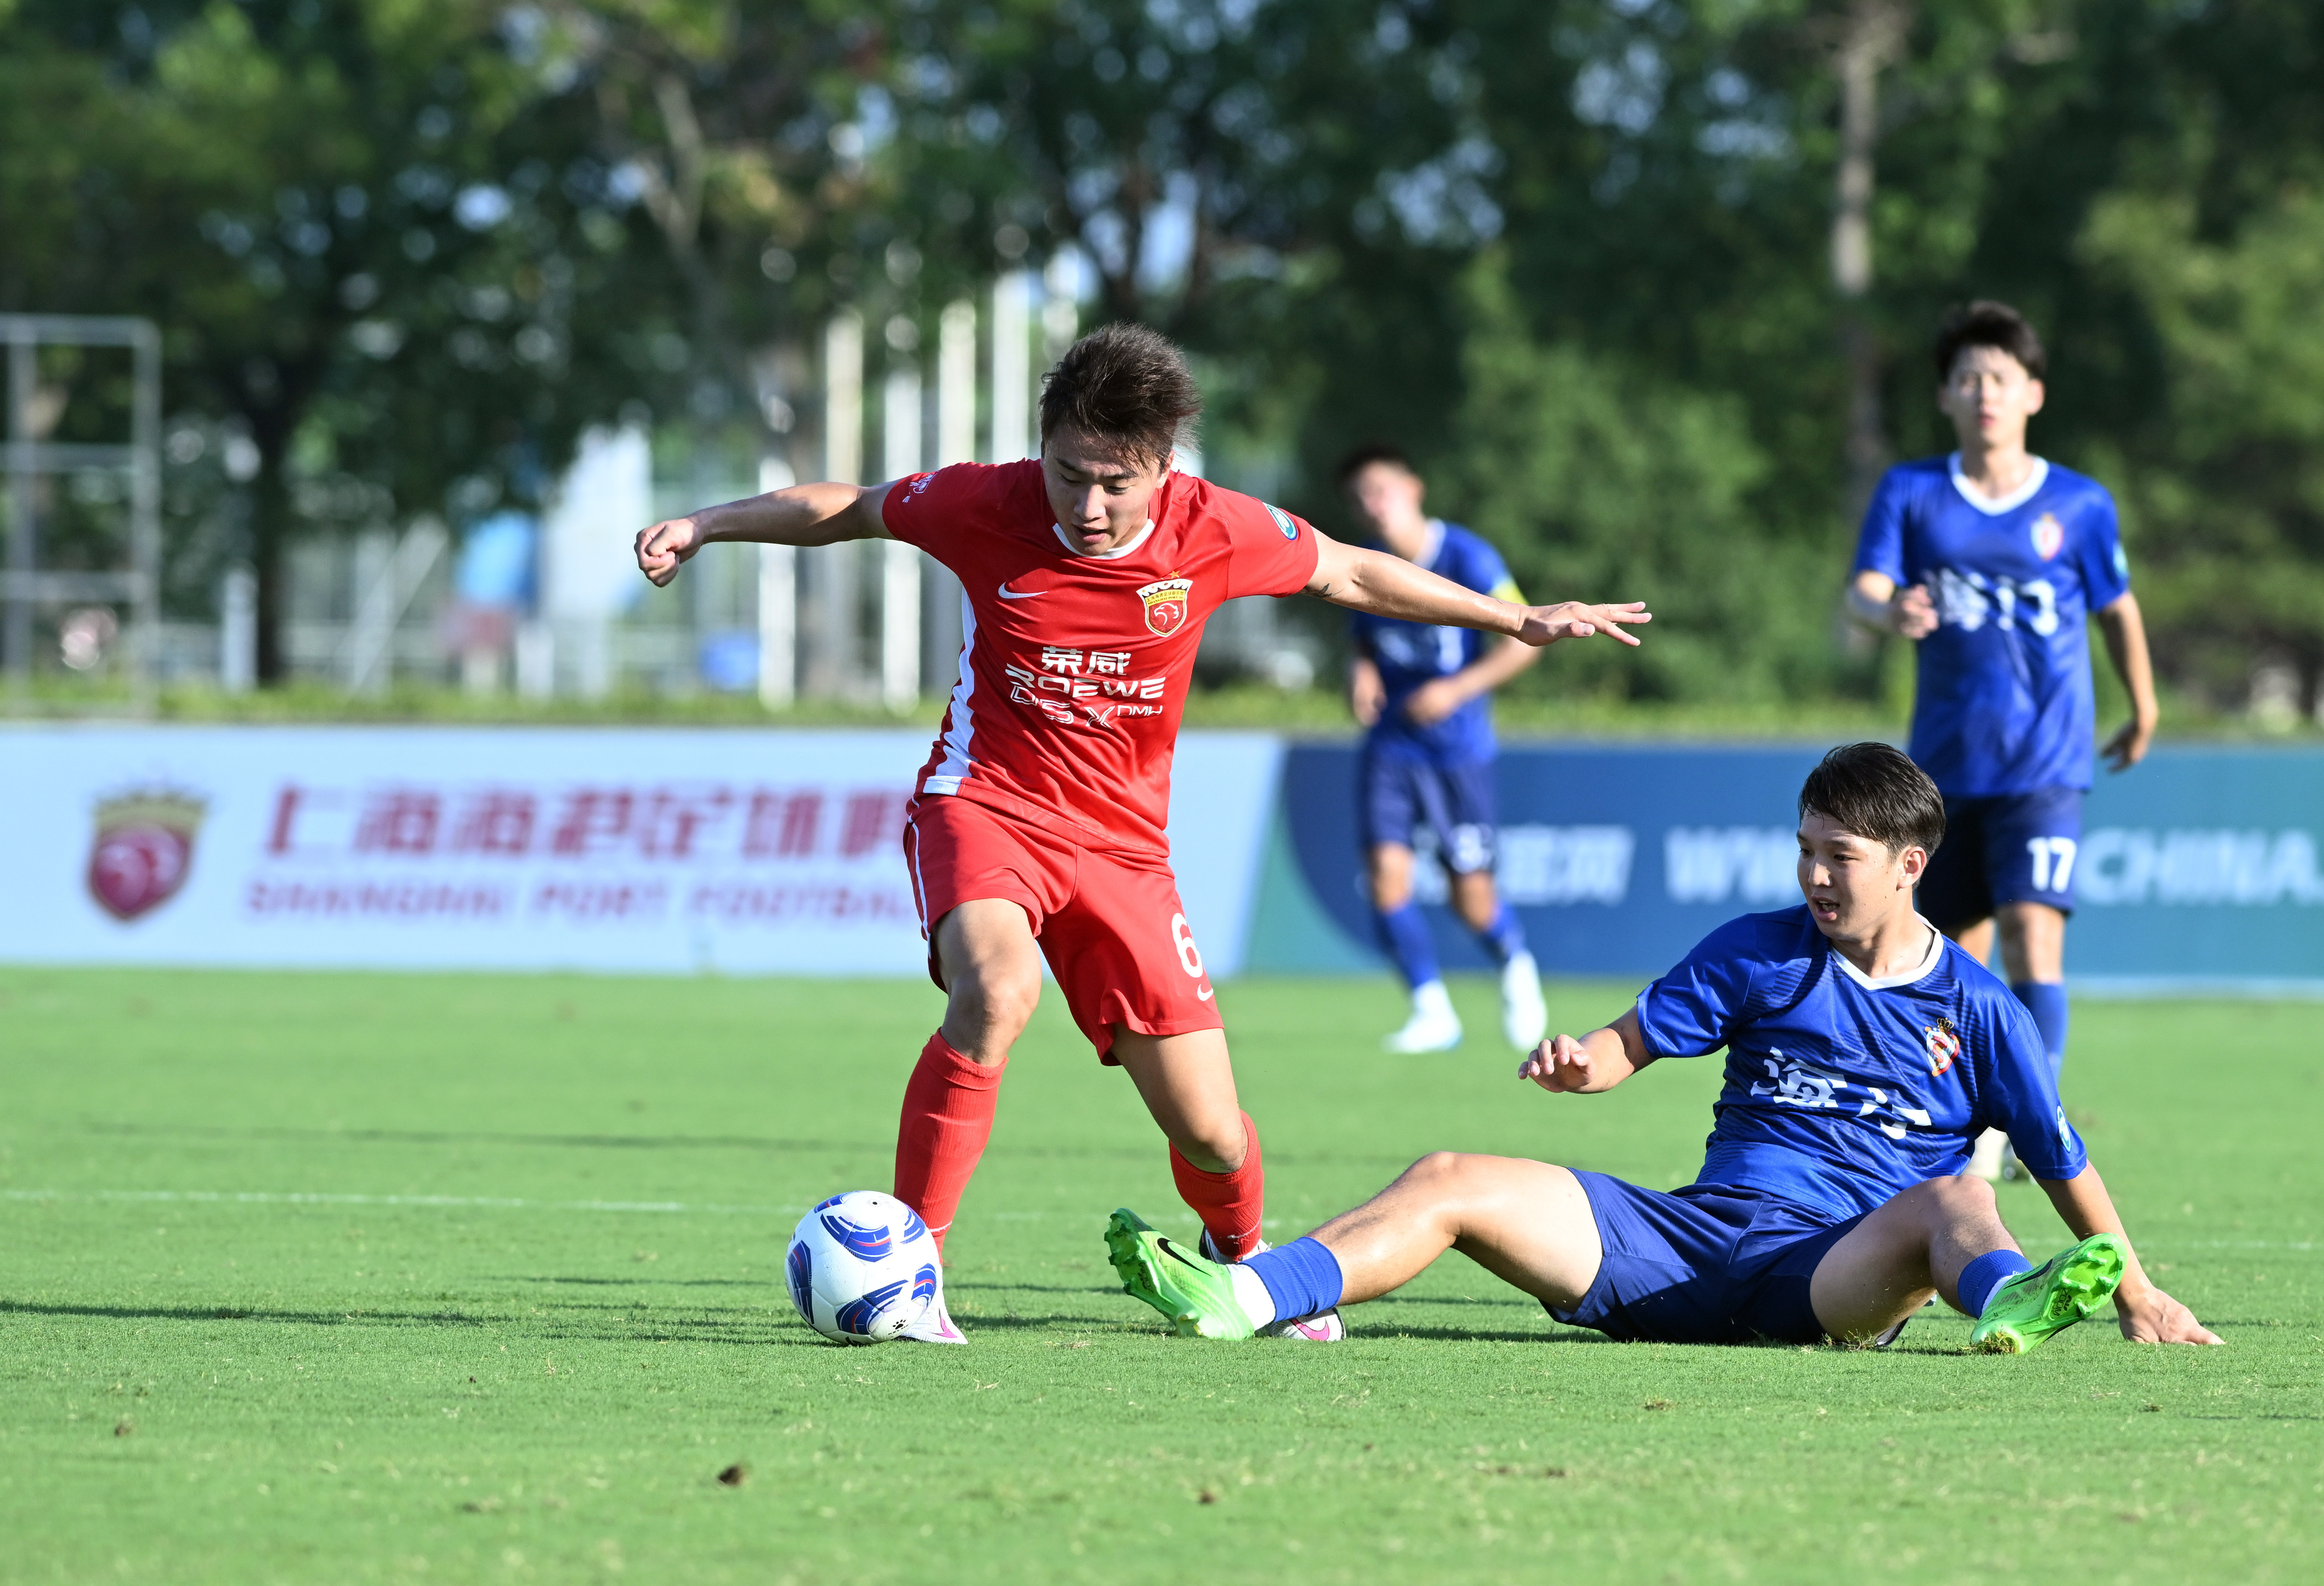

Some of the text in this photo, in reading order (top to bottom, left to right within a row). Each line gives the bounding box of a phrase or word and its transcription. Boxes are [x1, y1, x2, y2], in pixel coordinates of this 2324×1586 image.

[1041, 646, 1131, 676] 荣威
[1005, 663, 1166, 699] ROEWE
[2026, 836, 2077, 893] 17
[246, 882, 915, 921] SHANGHAI PORT FOOTBAL
[1171, 913, 1203, 978] 6
[2053, 1288, 2070, 1316] ZOOM
[888, 1323, 909, 1335] KELME
